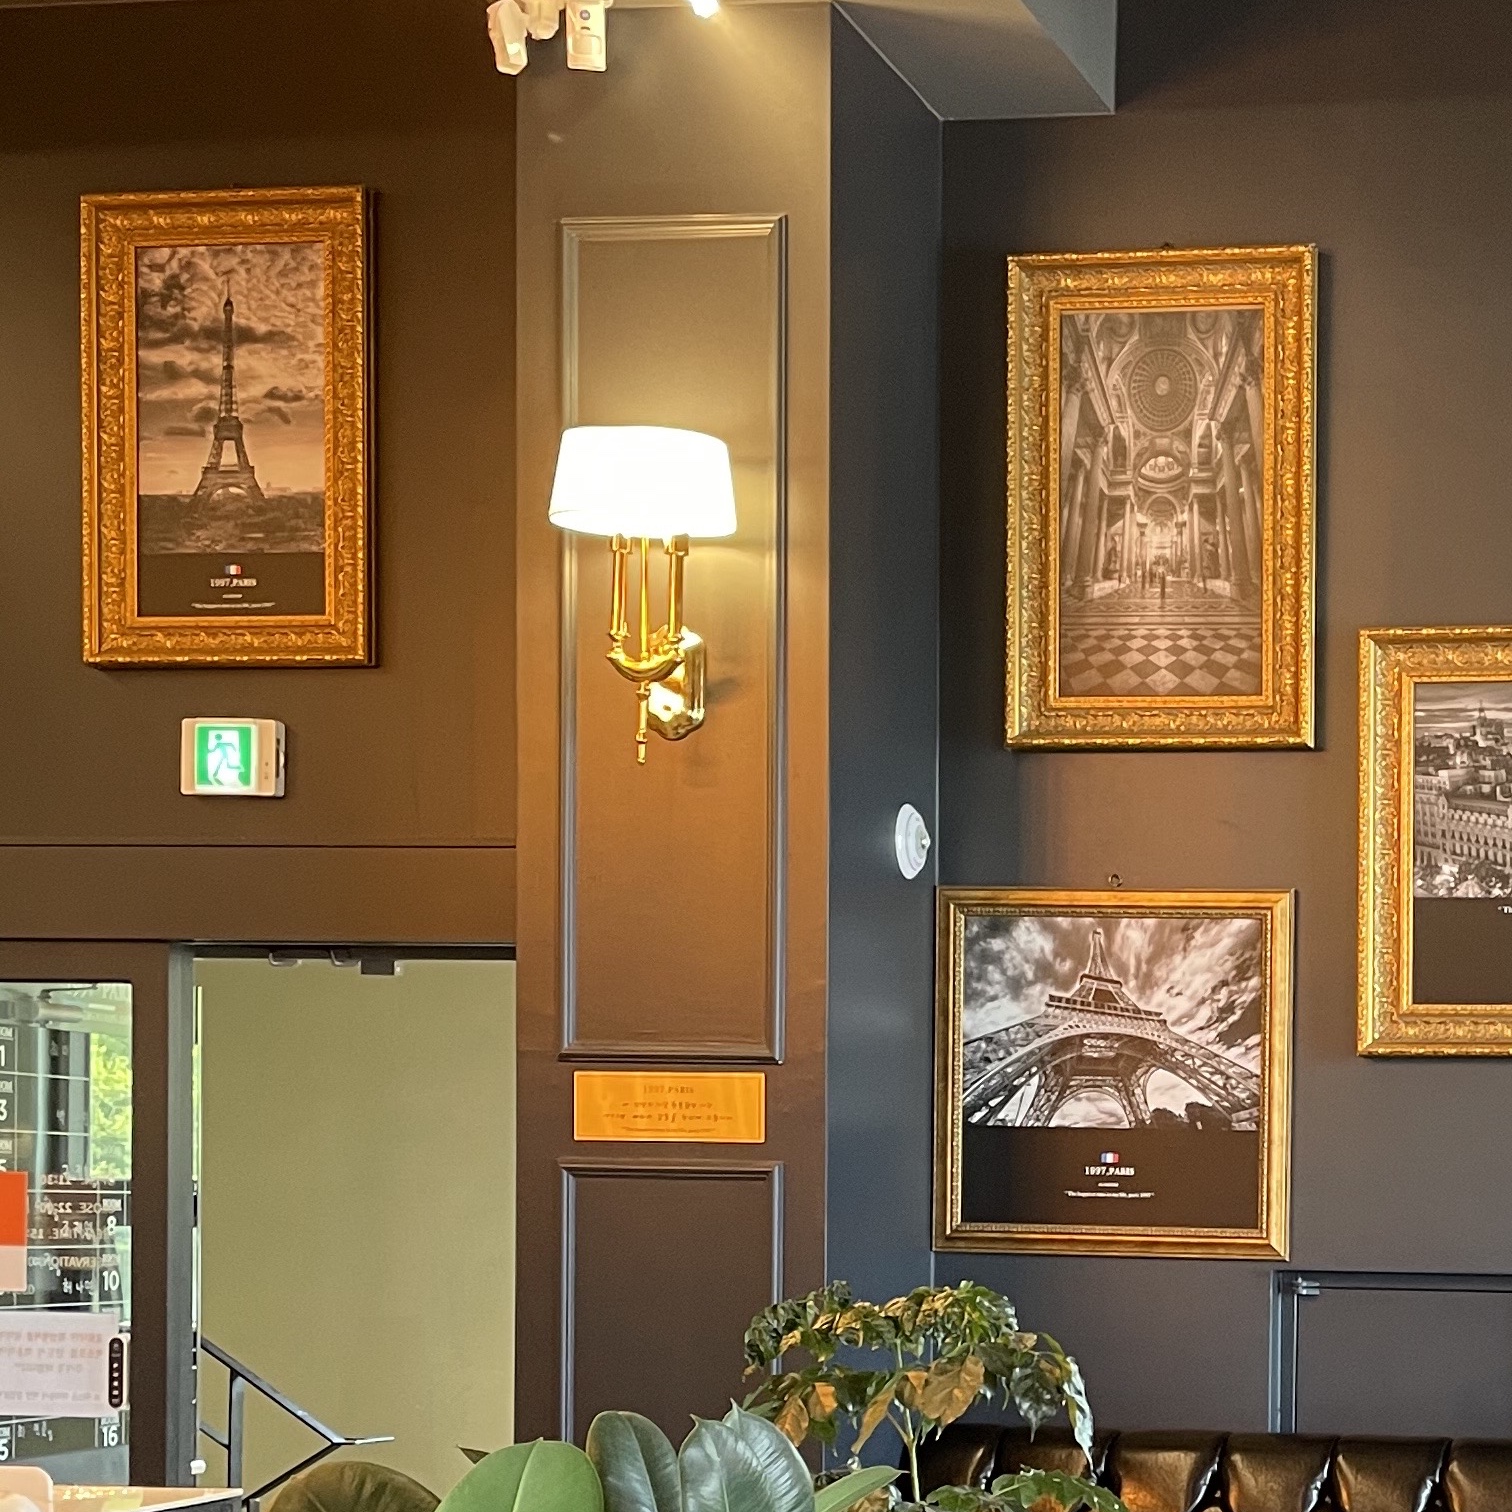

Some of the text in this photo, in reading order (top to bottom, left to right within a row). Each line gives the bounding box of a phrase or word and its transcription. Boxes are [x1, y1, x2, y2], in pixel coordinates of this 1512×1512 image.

[106, 1215, 117, 1236] 8
[102, 1270, 120, 1291] 10
[102, 1425, 118, 1447] 16
